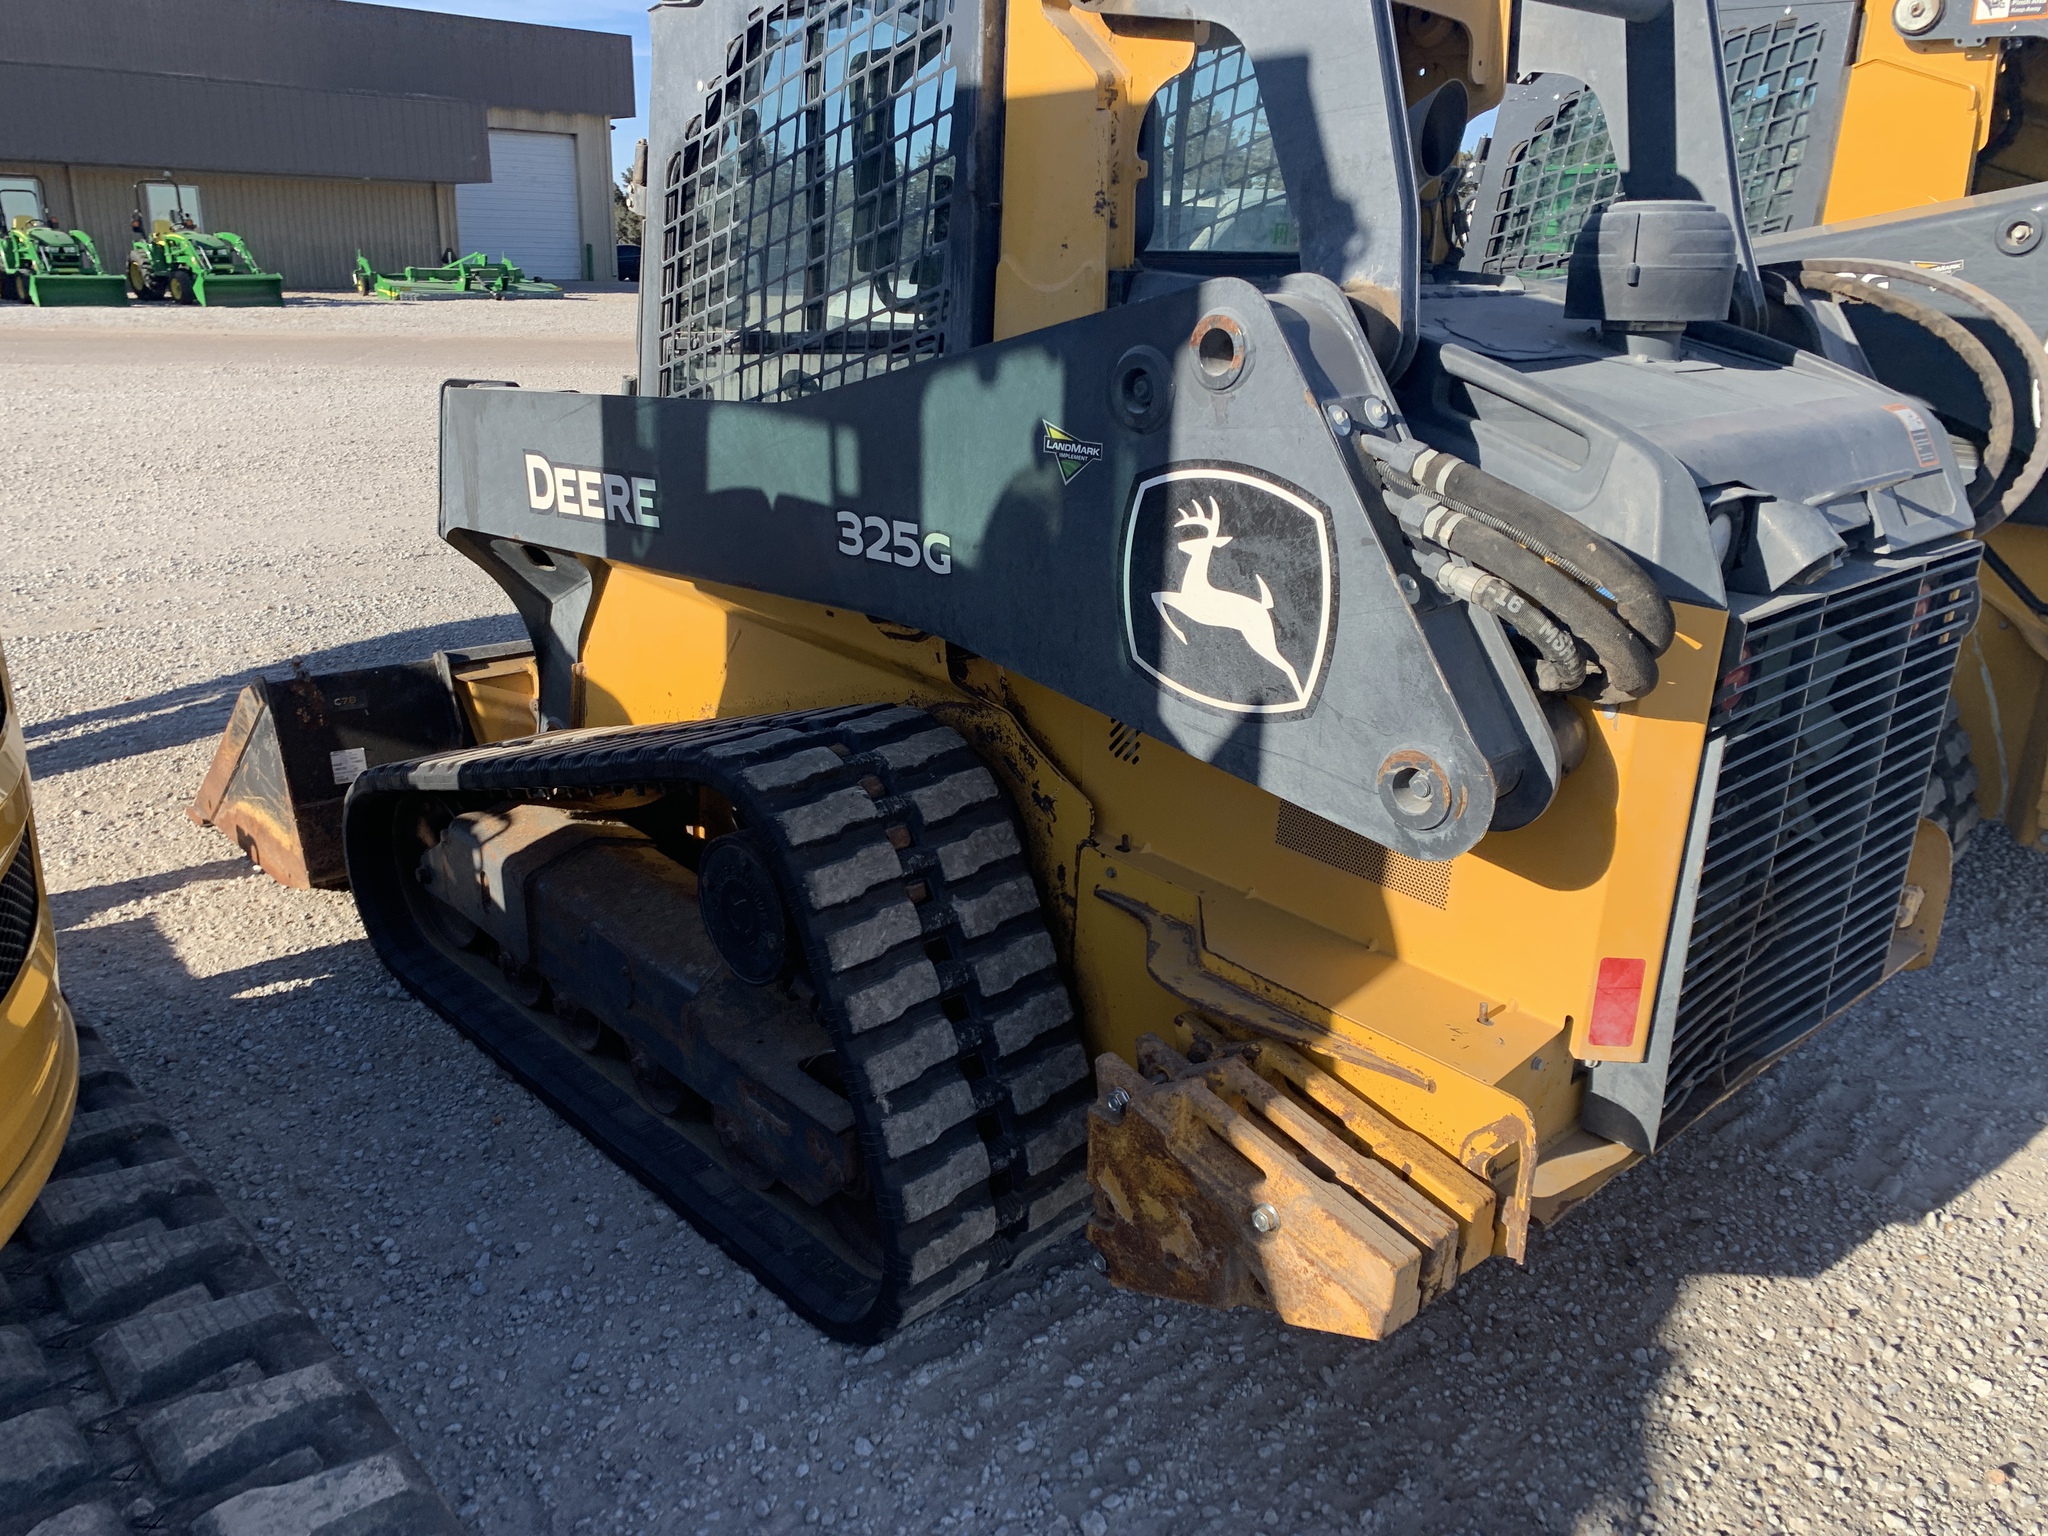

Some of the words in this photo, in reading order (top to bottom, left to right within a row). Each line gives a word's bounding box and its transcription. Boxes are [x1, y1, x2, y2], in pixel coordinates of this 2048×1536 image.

[1059, 452, 1088, 461] IMPLEMENT
[525, 453, 660, 529] DEERE
[836, 510, 951, 575] 325G
